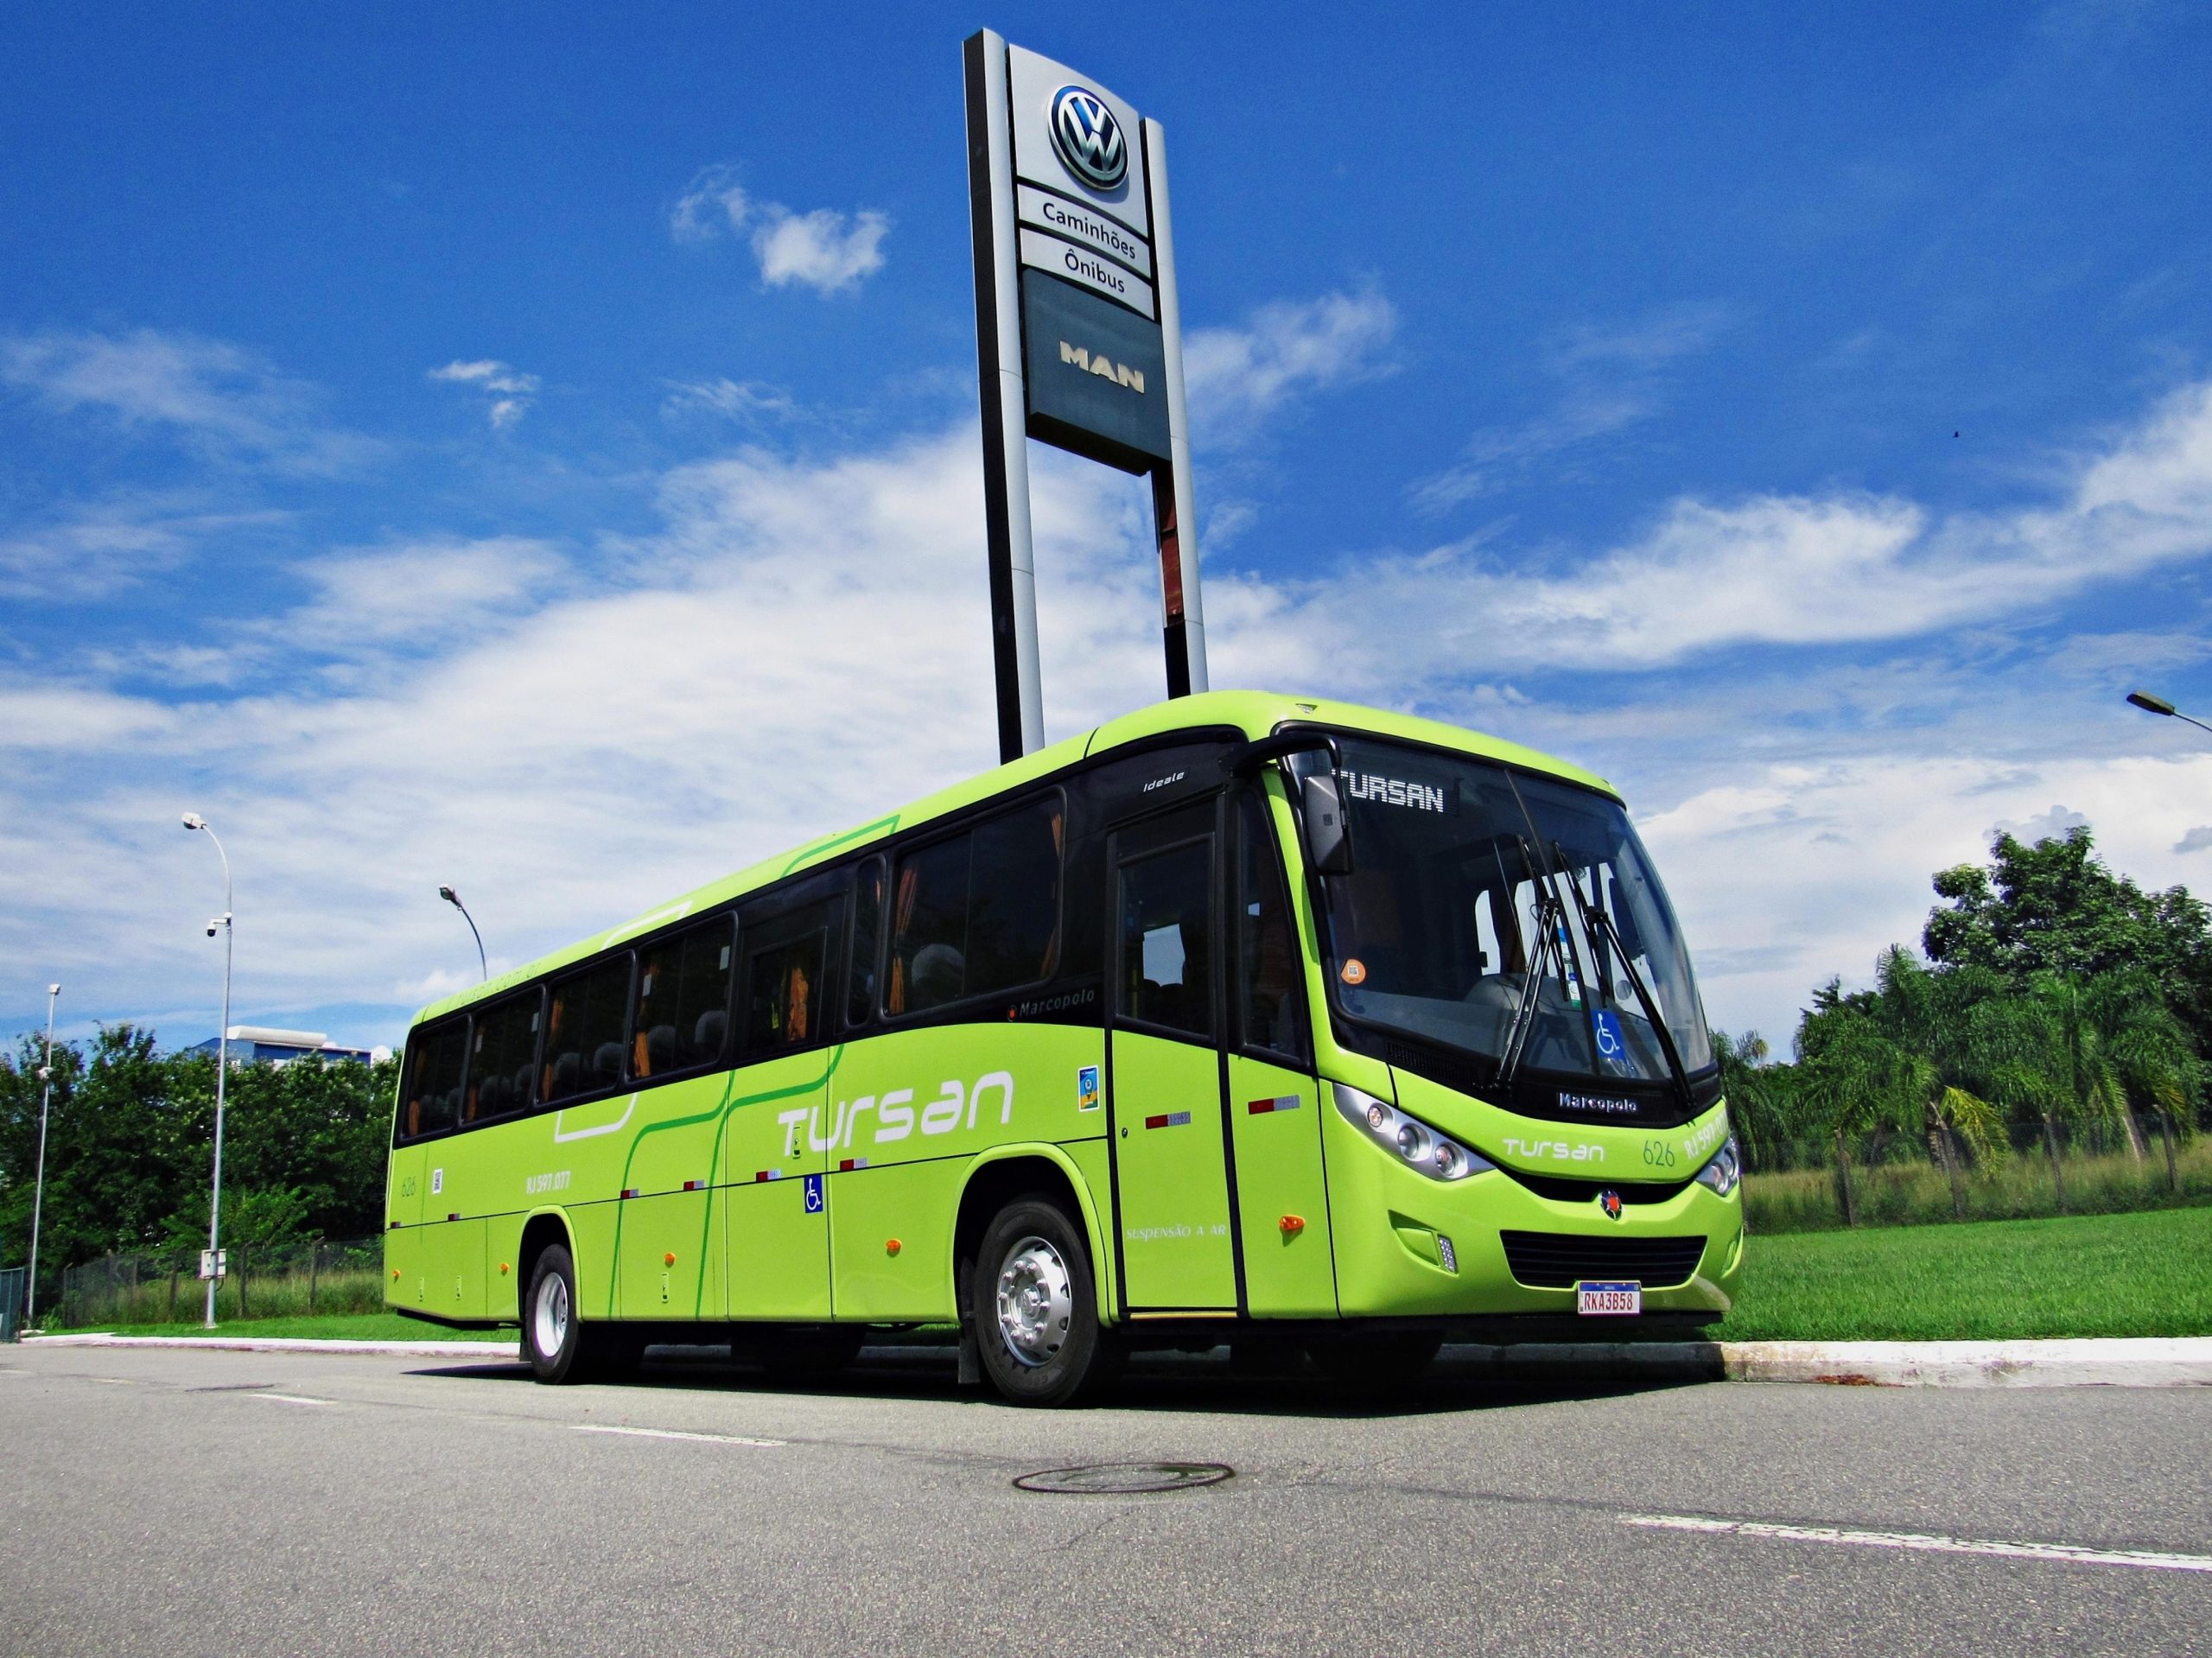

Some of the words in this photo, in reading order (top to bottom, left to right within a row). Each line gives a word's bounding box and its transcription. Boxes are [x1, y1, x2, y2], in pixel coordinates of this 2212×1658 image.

[1043, 202, 1136, 259] Caminhões
[1065, 248, 1125, 293] Ônibus
[1060, 340, 1145, 394] MAN
[1020, 989, 1095, 1017] Marcopolo
[1559, 1092, 1637, 1113] Marcopolo
[1643, 1140, 1675, 1167] 626
[401, 1176, 416, 1197] 626
[1126, 1223, 1191, 1242] SUSPENSÃO
[1197, 1225, 1205, 1236] A
[1211, 1224, 1226, 1236] AR
[1584, 1293, 1633, 1311] RKA3B58
